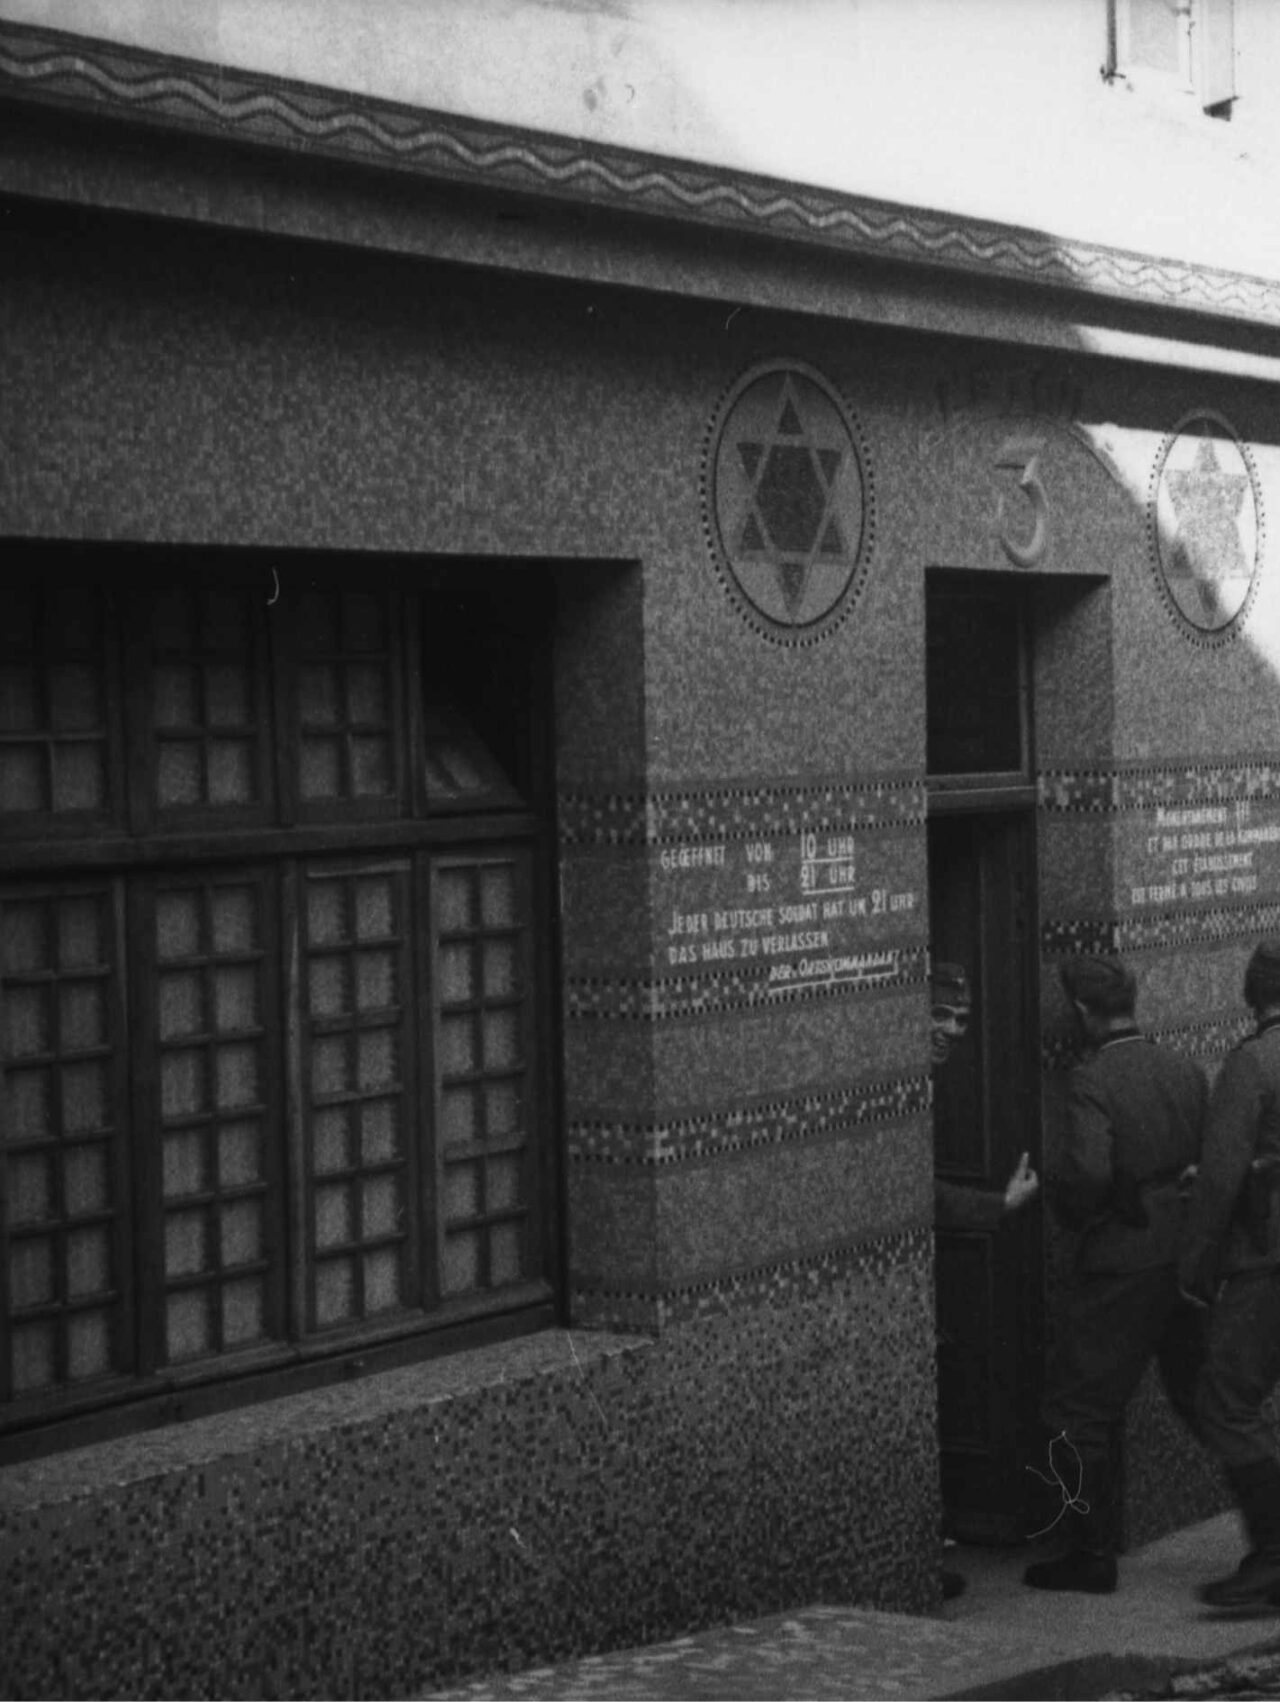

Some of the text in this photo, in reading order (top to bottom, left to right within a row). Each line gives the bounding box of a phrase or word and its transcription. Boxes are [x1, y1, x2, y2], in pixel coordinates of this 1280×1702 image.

[746, 843, 772, 863] VON
[801, 833, 816, 858] 10
[828, 836, 854, 857] UHR
[747, 866, 855, 892] BIS 21 UHR
[668, 889, 914, 935] JEDER DEUTSCHE SOLDAT HAT UM 21 UHR
[668, 931, 829, 965] DAS HAUS ZU VERLASSEN
